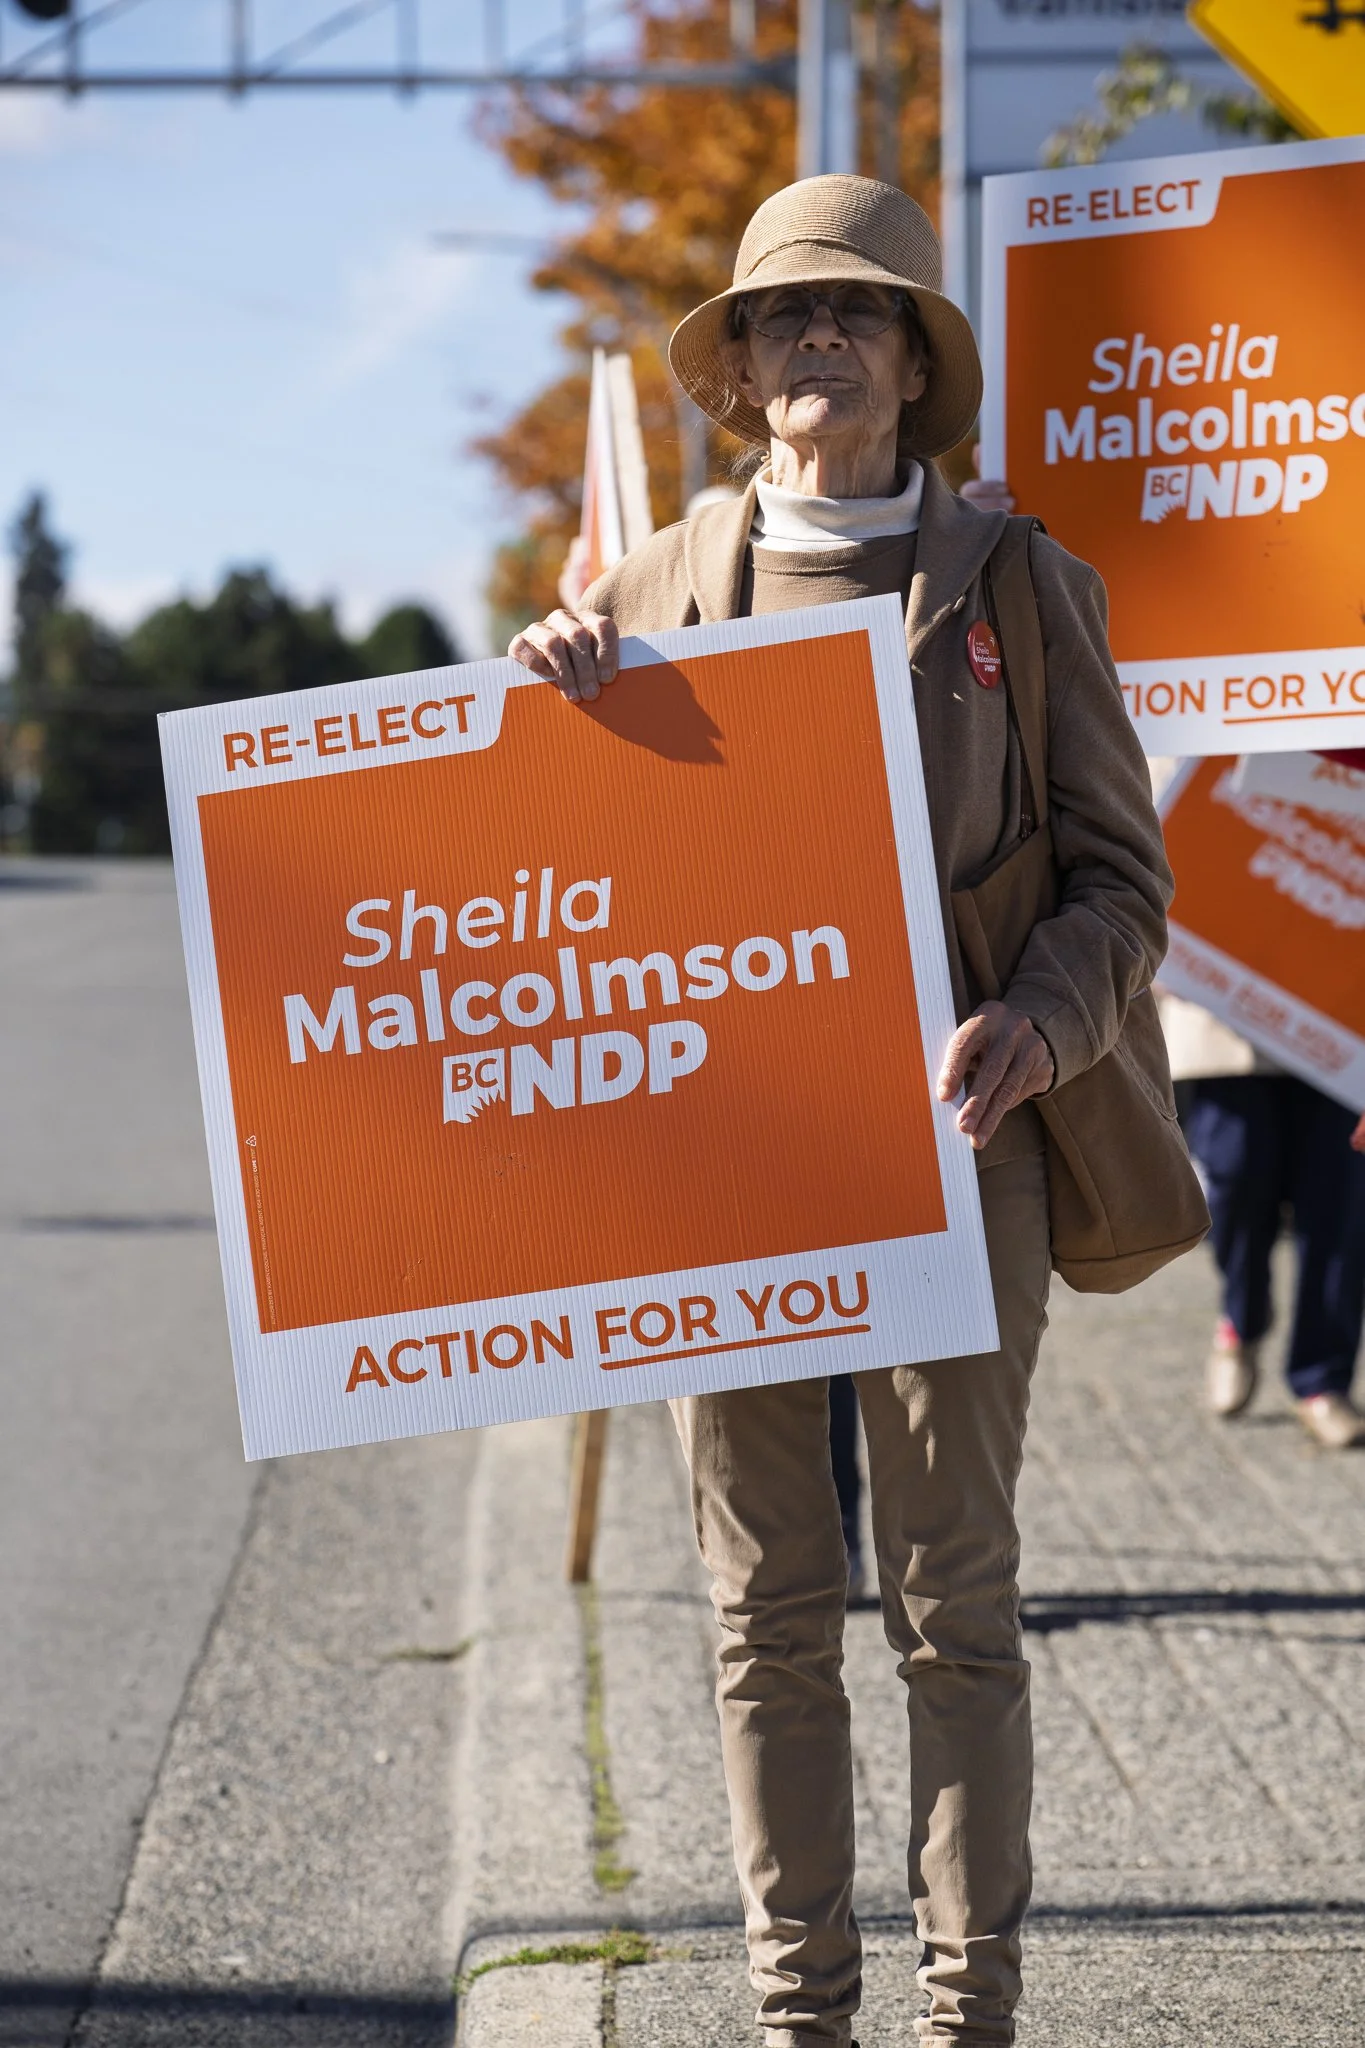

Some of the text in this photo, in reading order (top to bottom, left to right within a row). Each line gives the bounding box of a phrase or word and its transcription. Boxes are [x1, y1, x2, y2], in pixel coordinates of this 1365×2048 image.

[1026, 180, 1202, 229] RE-ELECT
[1088, 323, 1279, 394] Sheila
[1186, 453, 1329, 521] NDP
[222, 693, 476, 773] RE-ELECT
[1223, 674, 1306, 712] FOR
[342, 866, 612, 969] Sheila
[283, 923, 850, 1065] Malcolmson
[510, 1019, 708, 1117] NDP
[345, 1270, 870, 1393] ACTION FOR YOU
